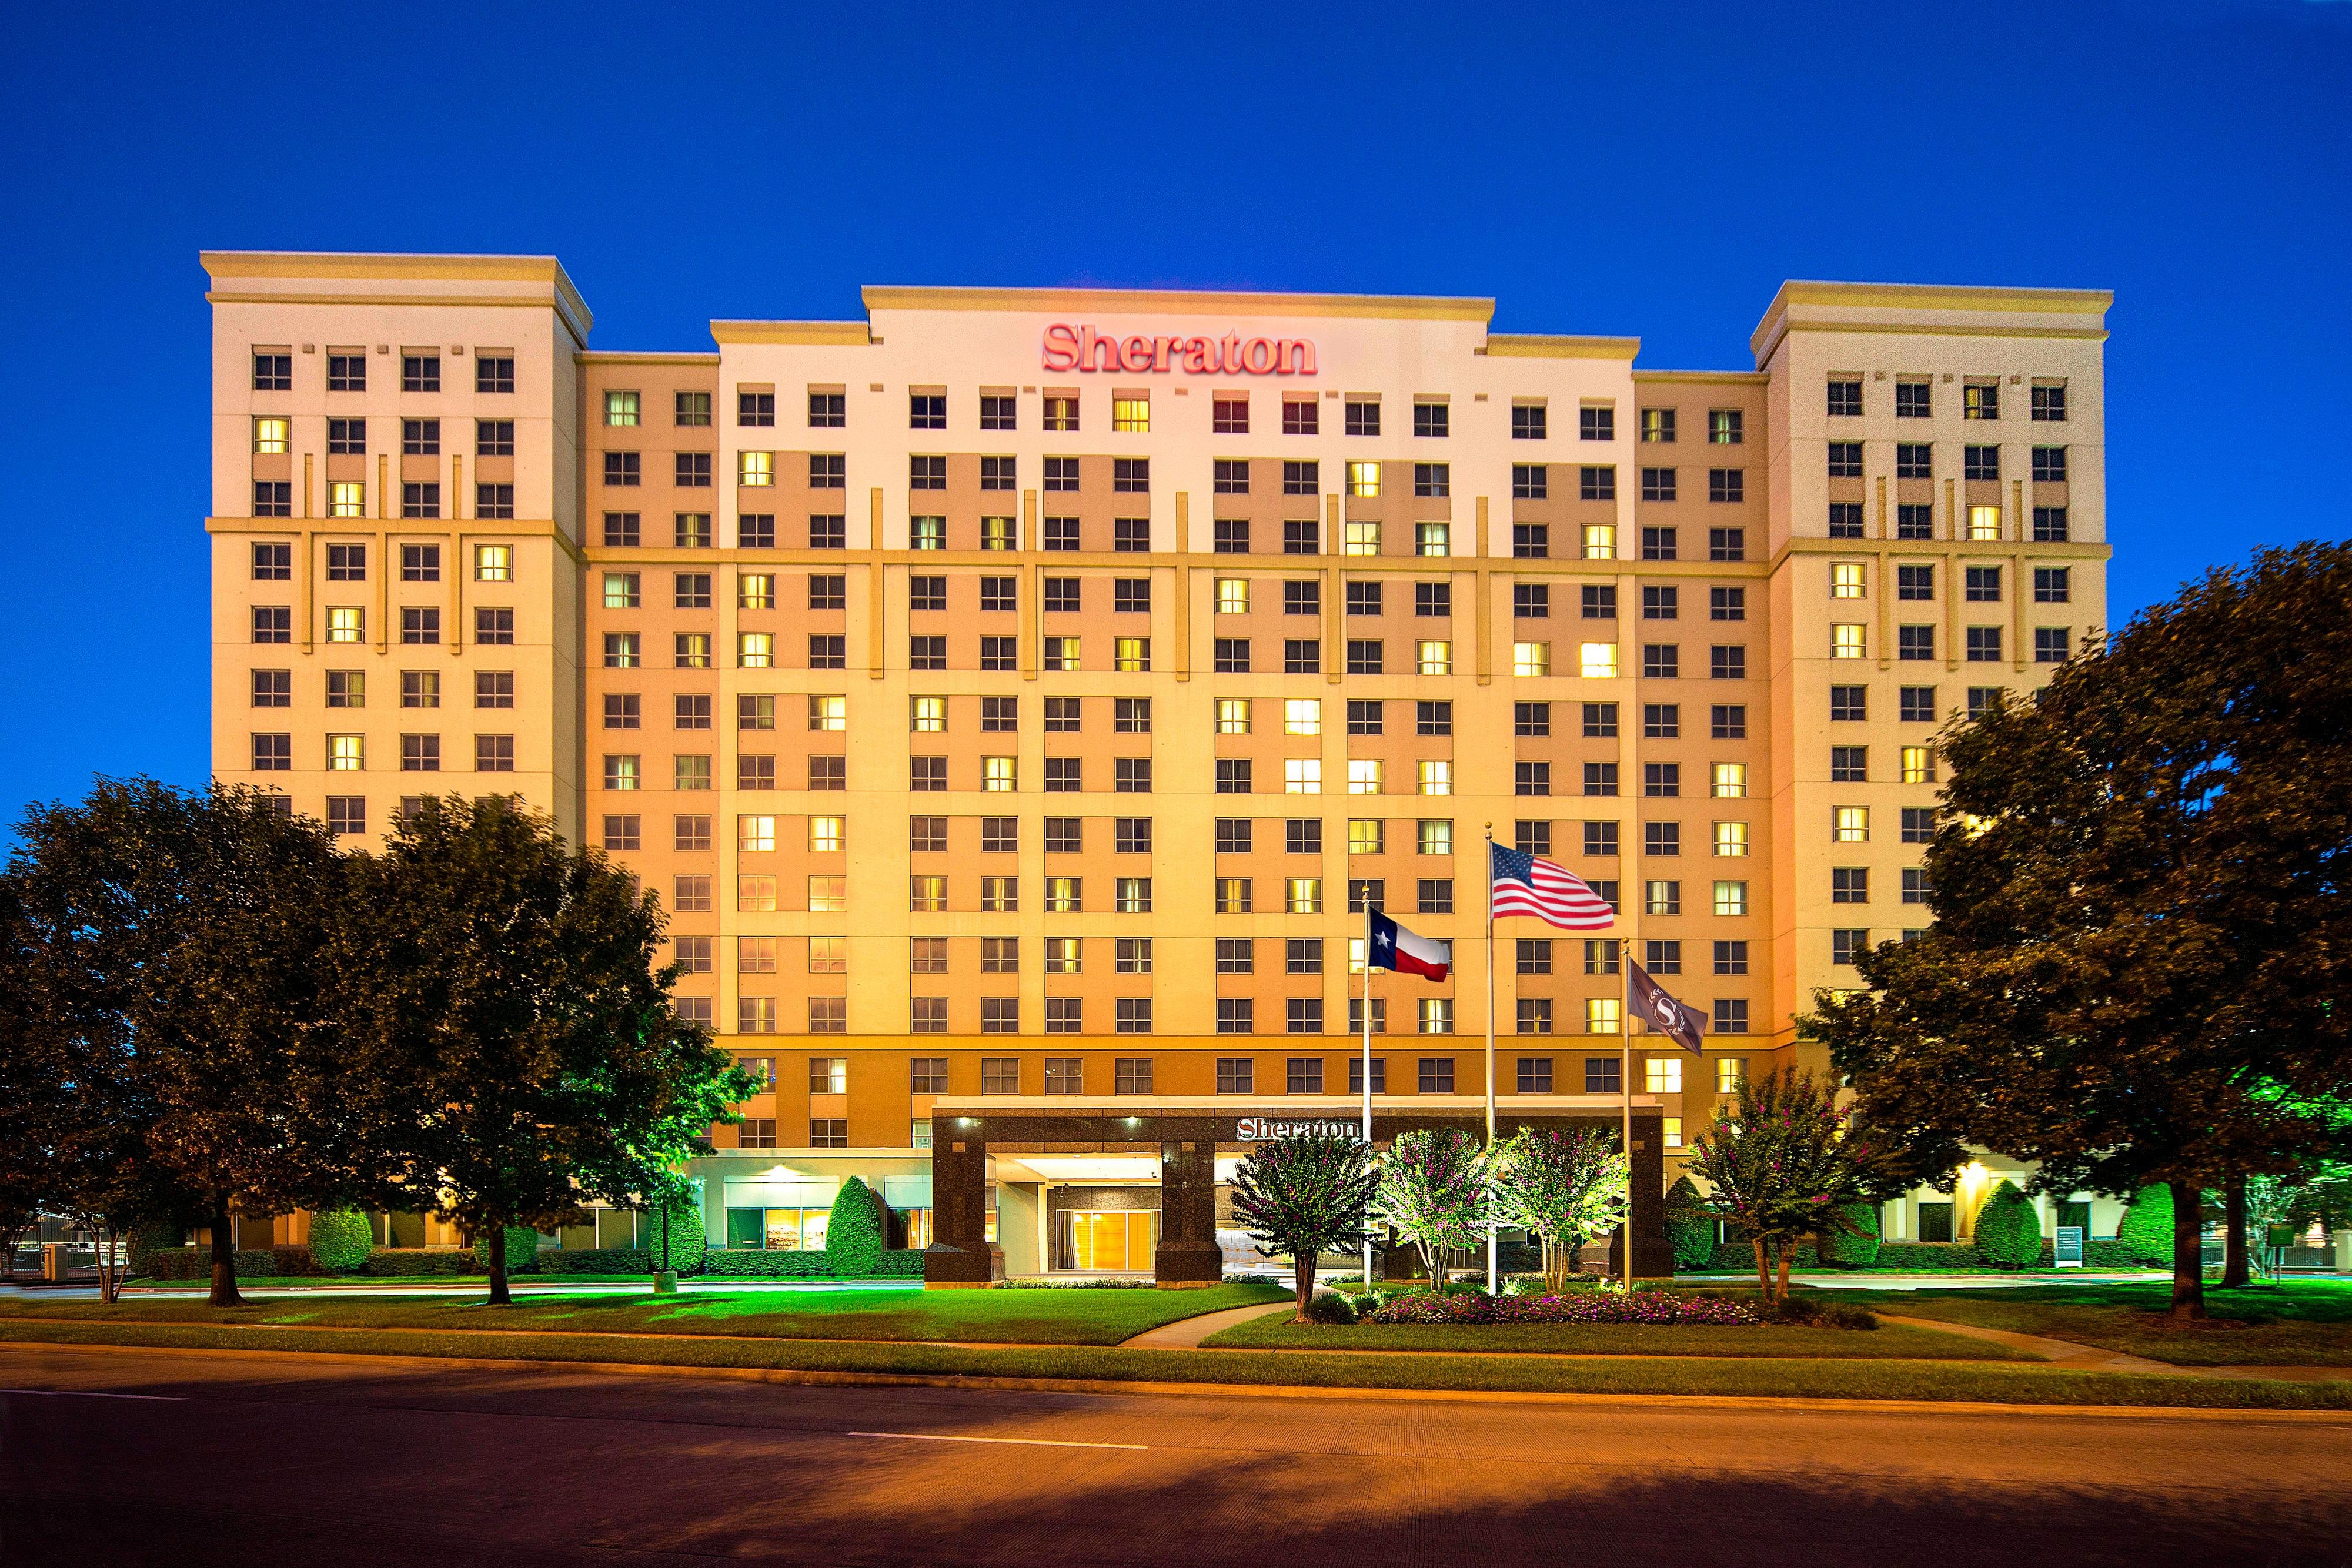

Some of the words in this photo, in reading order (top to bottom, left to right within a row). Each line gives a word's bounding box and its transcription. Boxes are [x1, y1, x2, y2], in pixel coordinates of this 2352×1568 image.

[1043, 322, 1318, 375] Sheraton
[1654, 998, 1676, 1026] S
[1238, 1118, 1359, 1138] Sheraton
